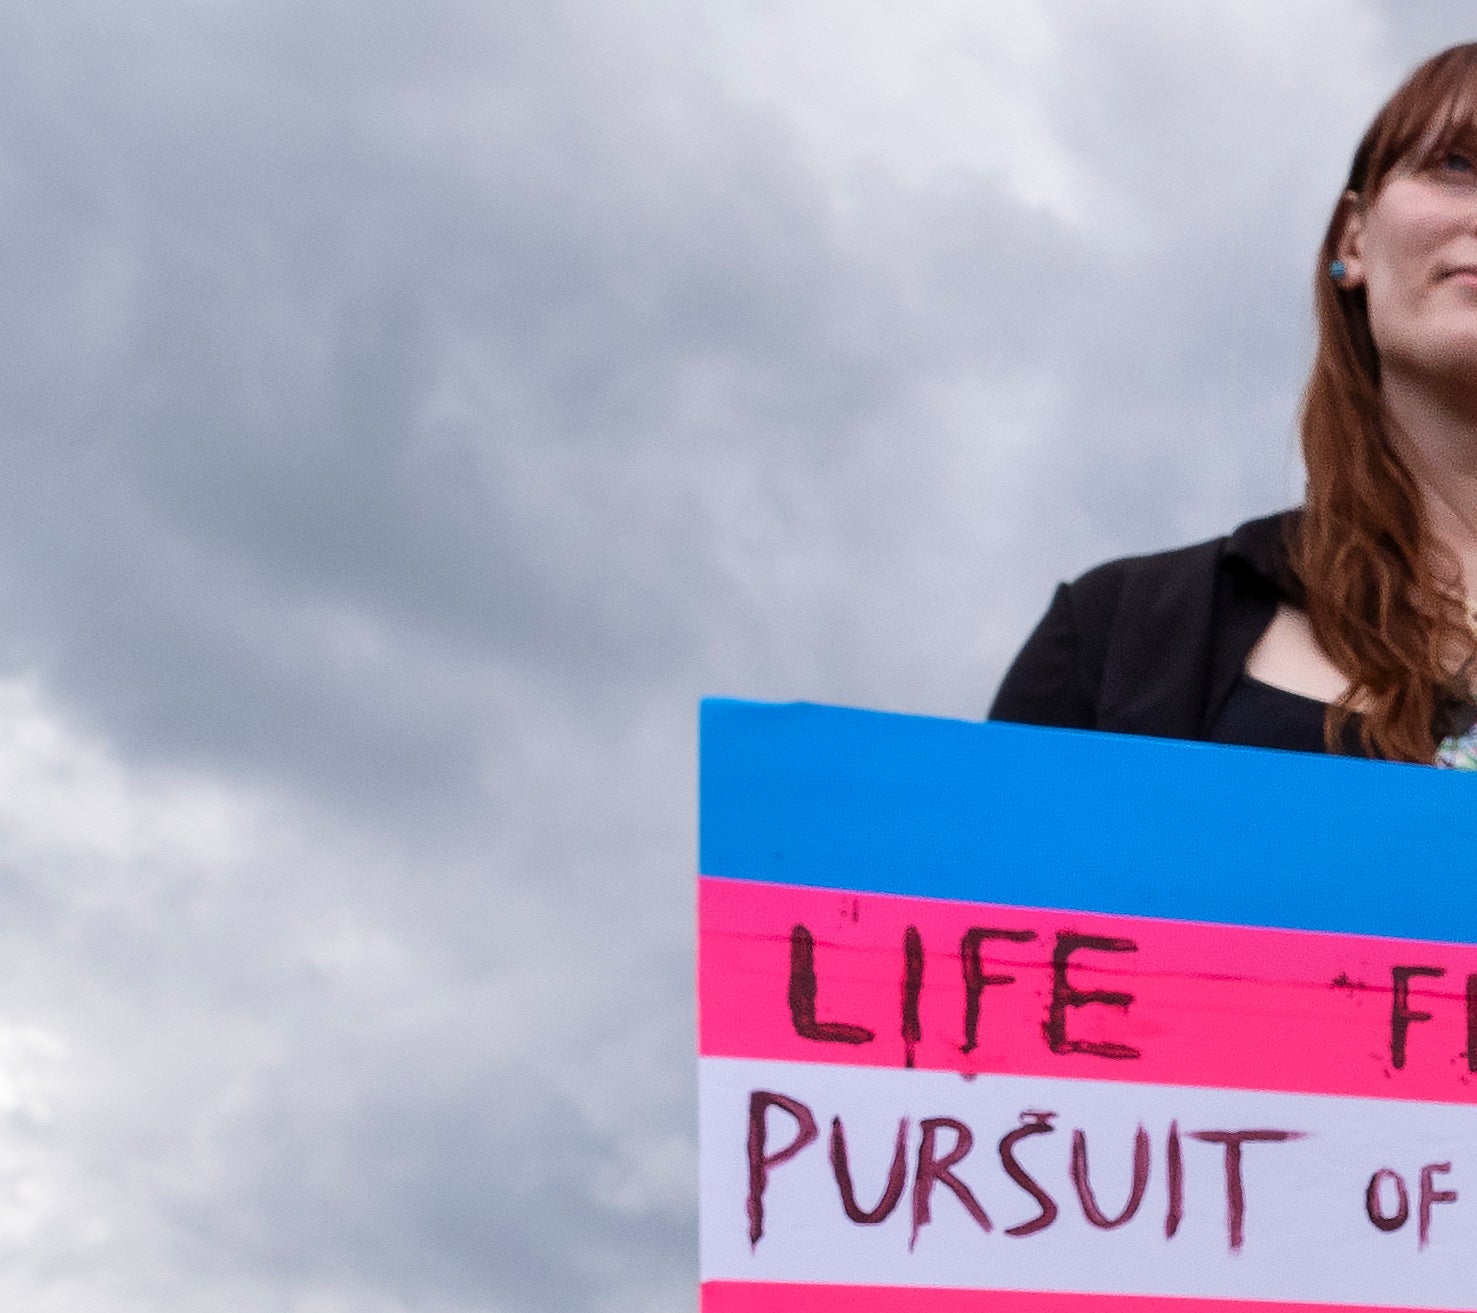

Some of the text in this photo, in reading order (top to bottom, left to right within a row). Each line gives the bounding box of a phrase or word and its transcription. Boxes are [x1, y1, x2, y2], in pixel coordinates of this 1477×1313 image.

[789, 924, 1141, 1068] LIFE
[747, 1091, 1304, 1251] PURSUIT
[1364, 1161, 1458, 1246] OF
